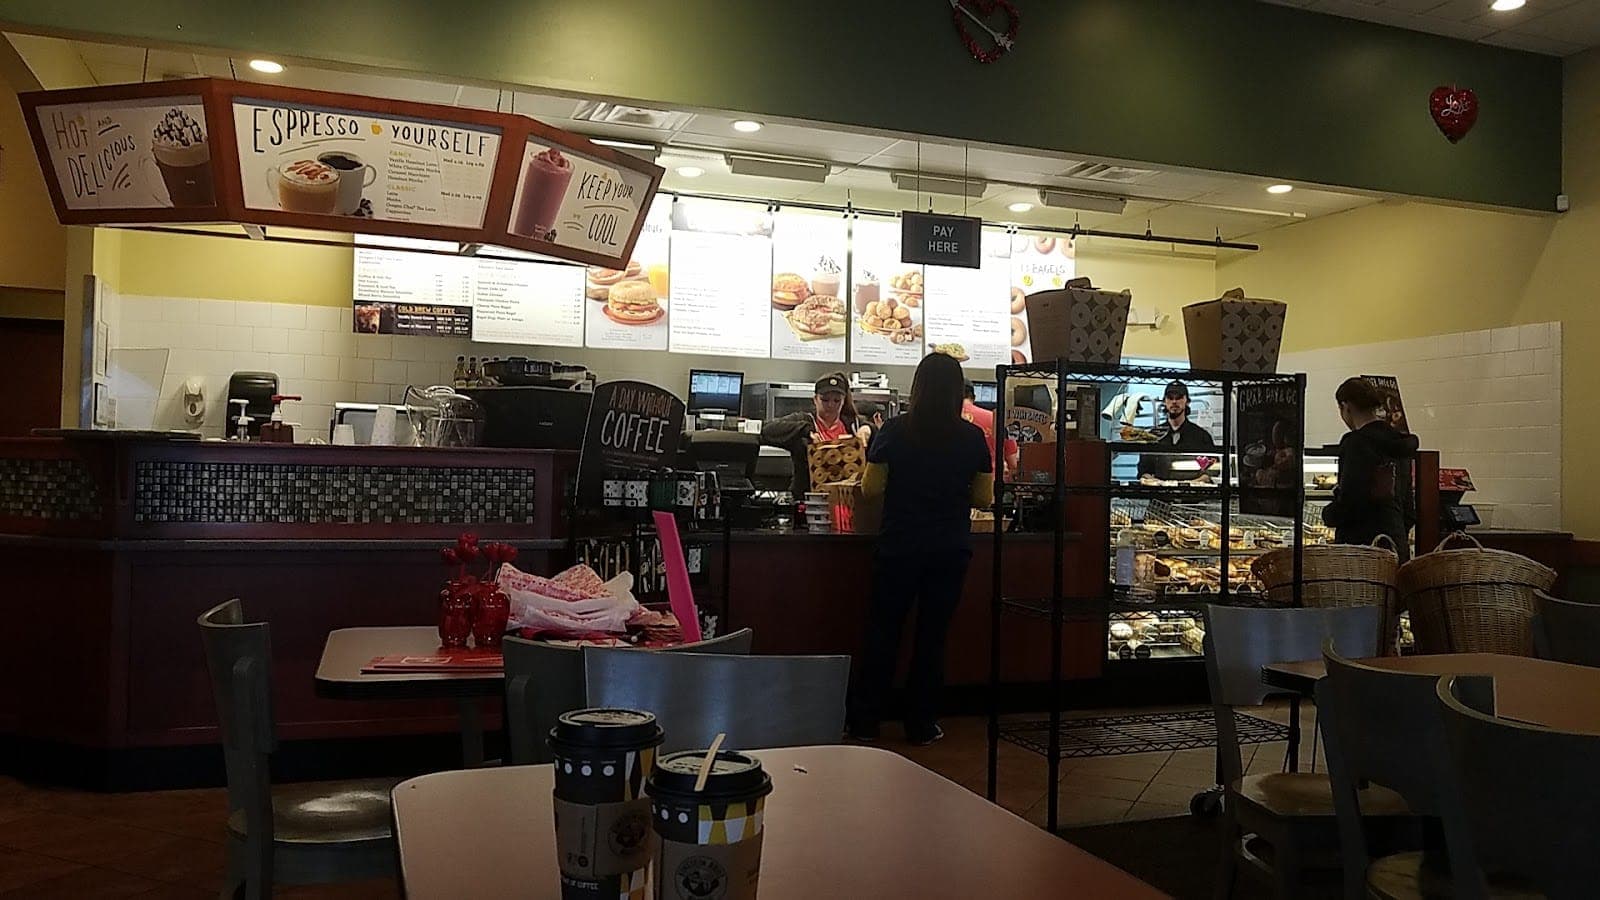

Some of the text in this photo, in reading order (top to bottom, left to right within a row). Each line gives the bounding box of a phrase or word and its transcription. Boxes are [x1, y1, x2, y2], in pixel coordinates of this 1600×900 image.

[52, 111, 88, 150] HOT
[253, 108, 490, 157] ESPRESSO YOURSELF
[67, 135, 136, 198] DELICIOUS
[577, 171, 634, 201] KEEP YOUR
[588, 213, 618, 246] COOL
[933, 225, 955, 238] PAY
[928, 241, 959, 254] HERE
[1031, 263, 1066, 276] BAGELS
[398, 304, 455, 315] COLD BREW COFFEE
[609, 385, 674, 418] A DAY WITHOUT
[601, 410, 670, 454] COFFEE
